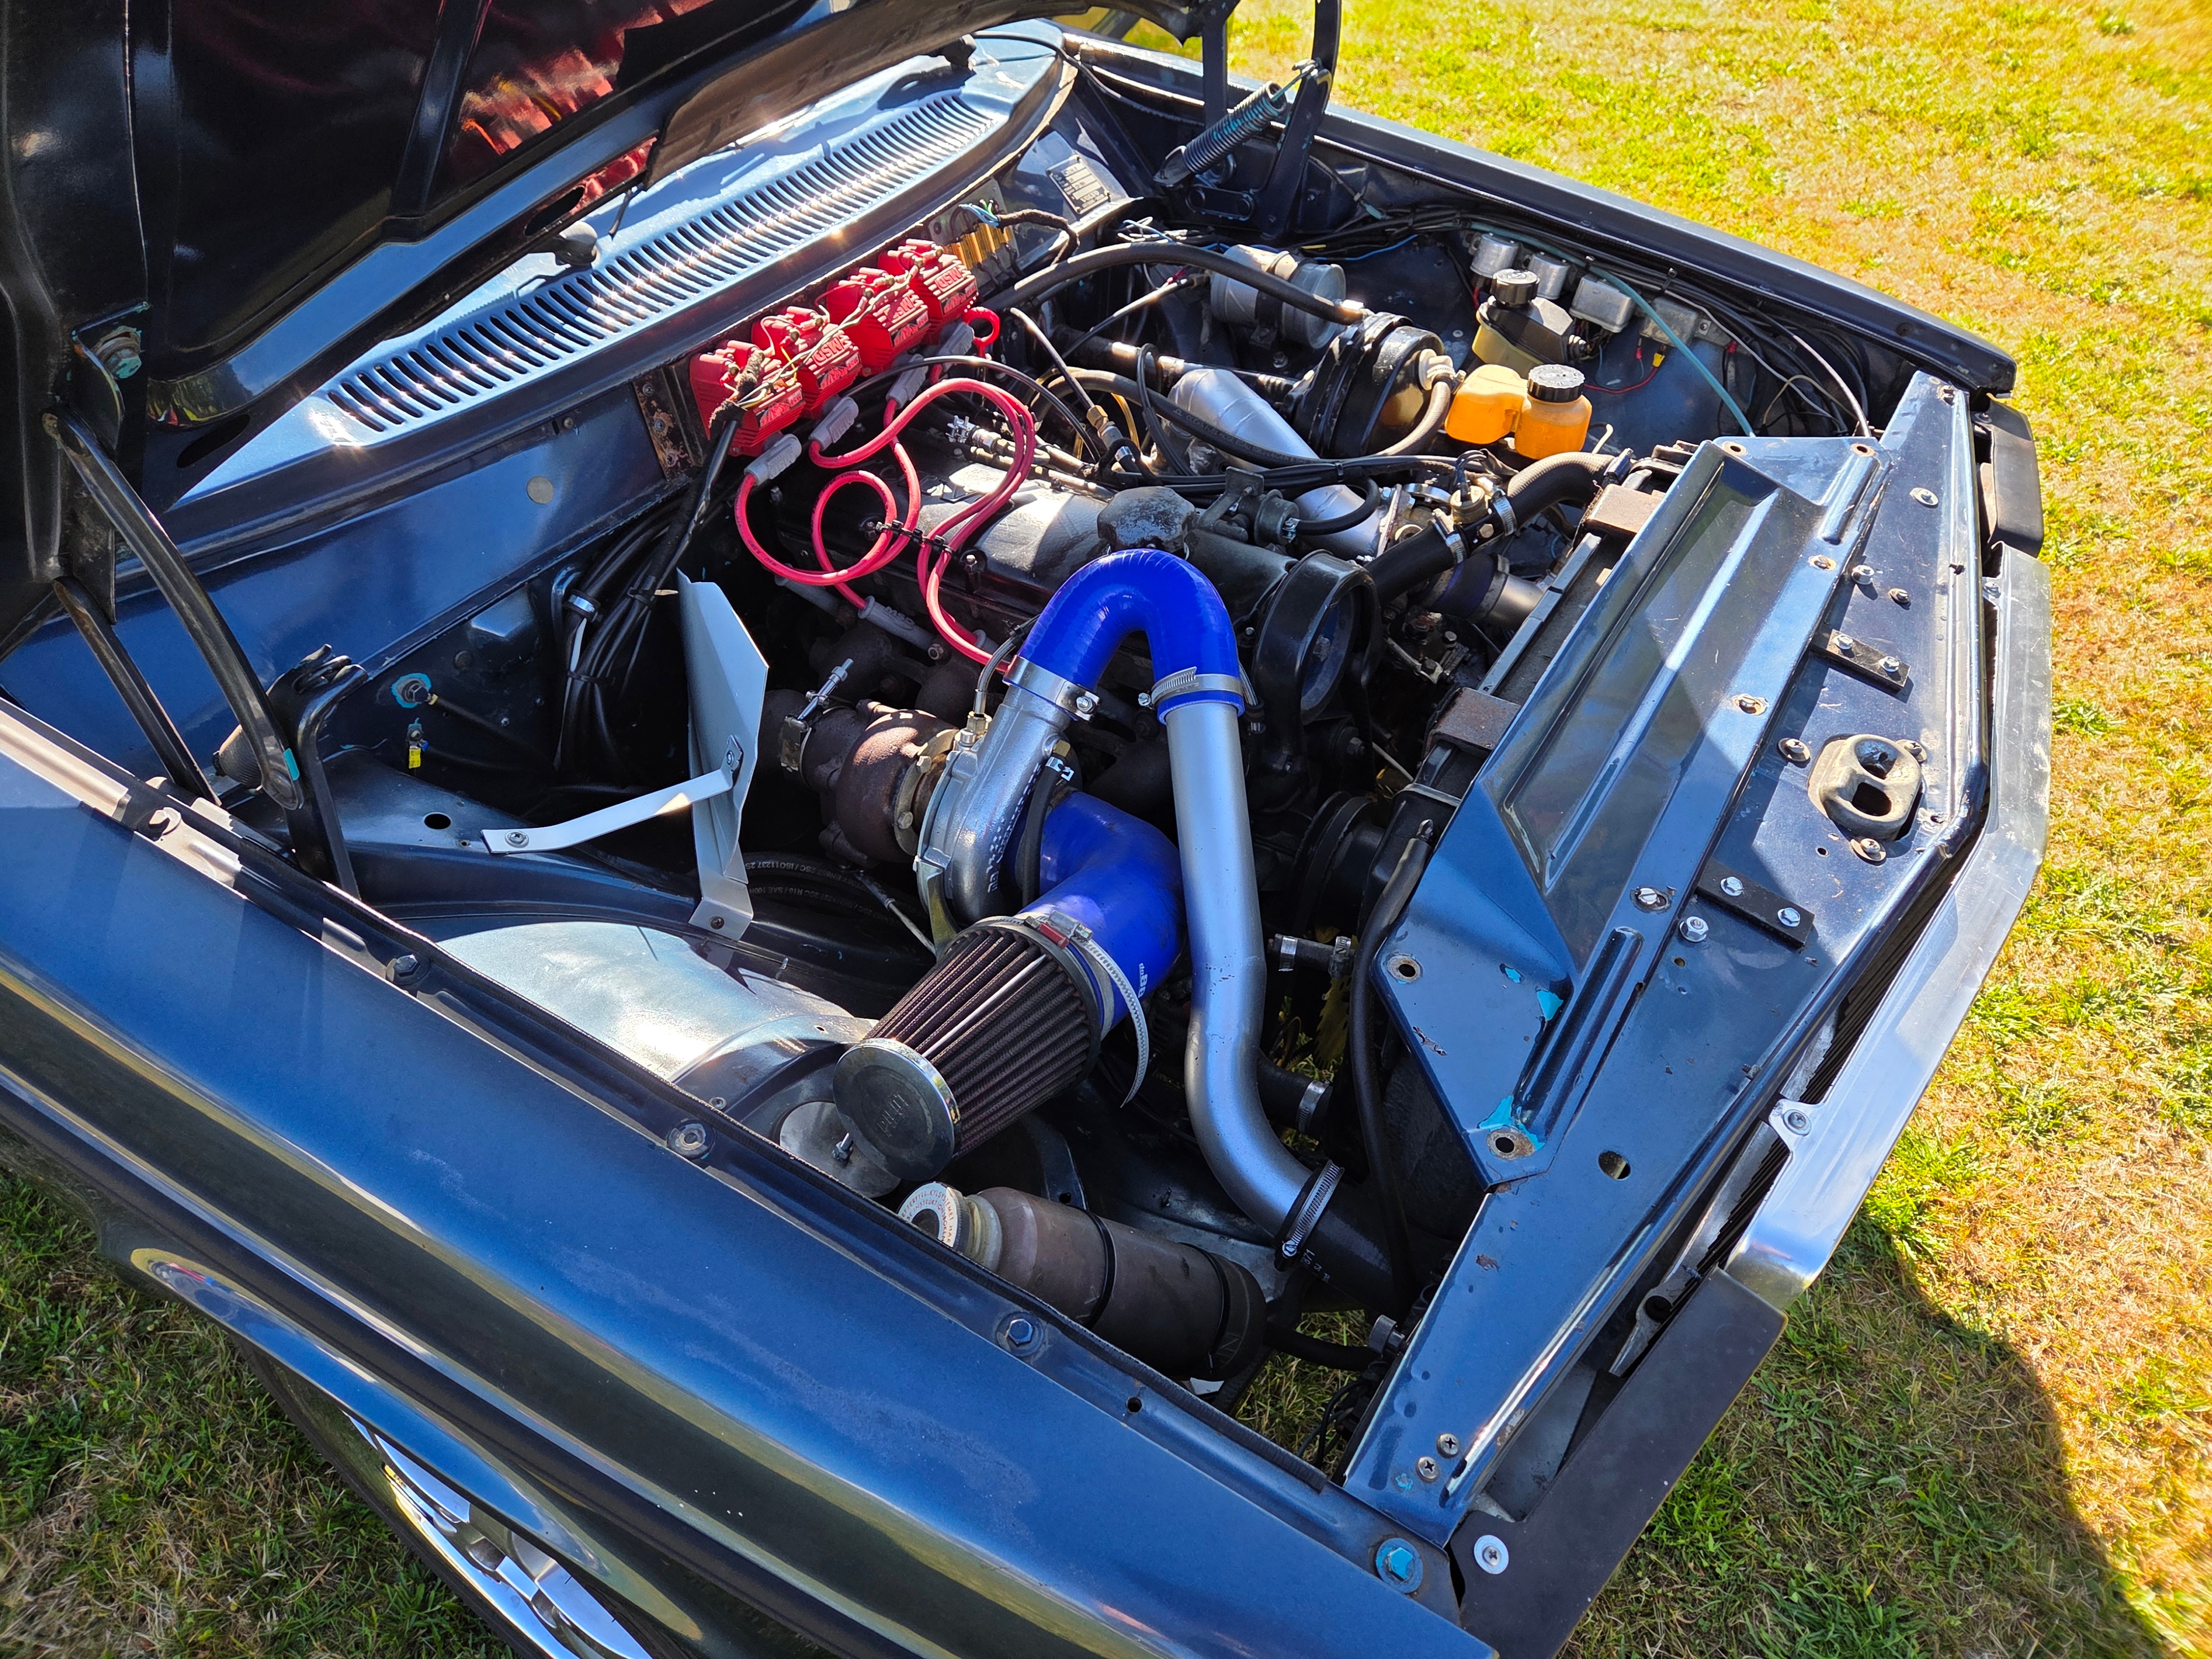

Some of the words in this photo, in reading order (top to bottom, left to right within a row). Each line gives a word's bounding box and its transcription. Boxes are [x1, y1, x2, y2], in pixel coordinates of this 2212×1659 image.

[935, 267, 962, 289] MSD
[812, 337, 843, 363] MSD
[884, 605, 916, 627] MSD
[757, 861, 795, 870] ISO11237
[800, 862, 817, 874] 2SC
[767, 885, 783, 895] SAE
